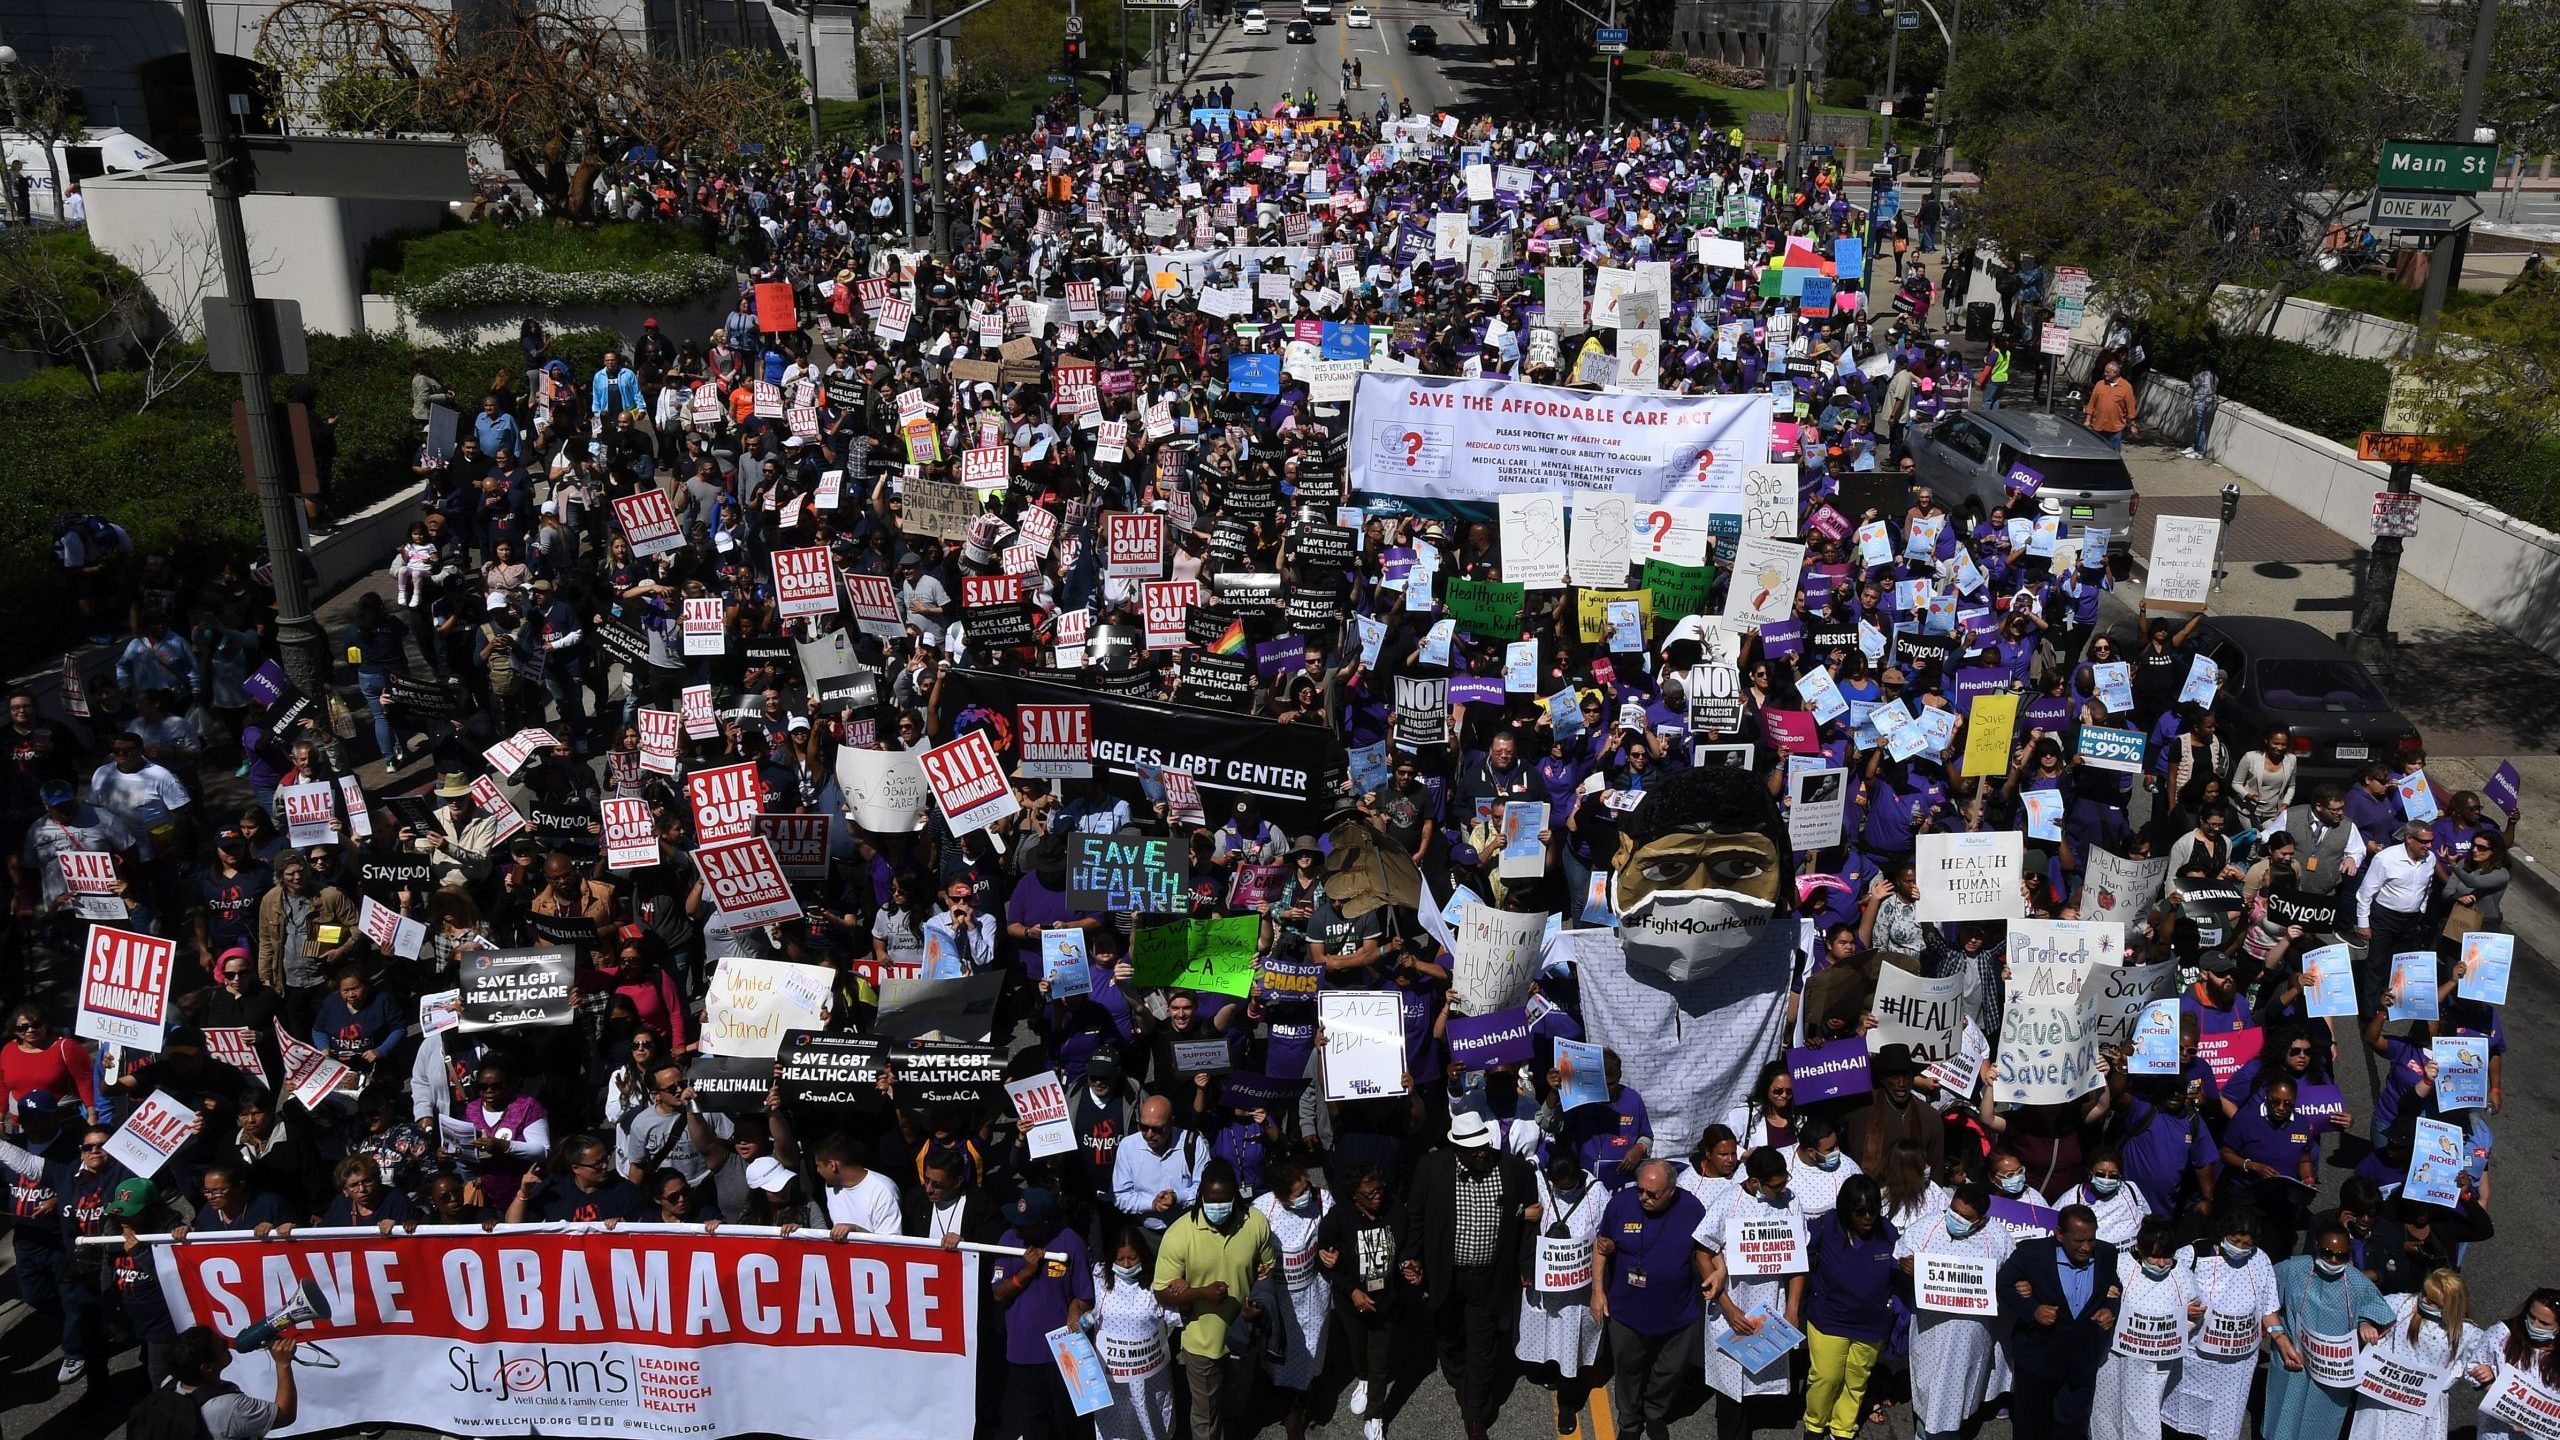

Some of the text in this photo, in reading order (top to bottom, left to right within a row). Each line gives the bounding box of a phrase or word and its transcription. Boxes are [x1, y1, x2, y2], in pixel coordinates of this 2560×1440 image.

[1602, 31, 1622, 39] Main
[2391, 154, 2485, 174] Main St
[2383, 200, 2453, 219] ONE WAY
[1409, 391, 1711, 426] SAVE THE AFFORDABLE CARE ACT
[1496, 428, 1621, 446] PLEASE PROTECT MY HEALTH CARE
[967, 451, 1006, 464] SAVE
[1465, 441, 1652, 463] MEDICAID CUTS WILL HURT OUR ABILITY ACQUIRE
[1472, 457, 1642, 476] MEDICAL CARE MENTAL HEALTH SERVICES
[1498, 466, 1614, 482] SUBSTANCE ABUSE TREATMENT
[1498, 475, 1613, 491] DENTAL CARE VISION CARE
[1745, 472, 1783, 497] Save
[2010, 470, 2038, 489] ¡GOL!
[904, 477, 974, 501] HEALTHCARE
[619, 493, 667, 526] SAVE
[1113, 520, 1159, 539] SAVE
[1115, 539, 1158, 554] OUR
[2187, 535, 2203, 545] DIE
[778, 551, 827, 576] SAVE
[1112, 551, 1160, 563] HEALTHCARE
[782, 573, 828, 589] OUR
[783, 586, 830, 600] HEALTHCARE
[686, 601, 721, 620] SAVE
[686, 620, 722, 632] OBAMACARE
[1814, 632, 1857, 646] #RESISTE
[747, 648, 790, 659] #HEALTH4ALL
[1260, 647, 1304, 664] #Health4All
[1190, 667, 1242, 682] SAVE LGBT
[823, 682, 875, 701] #HEALTH4ALL
[1182, 677, 1248, 692] HEALTHCARE
[1398, 677, 1446, 706] NO!
[1450, 682, 1502, 695] #Health4All
[1692, 668, 1740, 699] NO!
[1960, 677, 2009, 691] #Health4All
[1692, 697, 1740, 709] ILLEGITIMATE
[1397, 707, 1444, 720] ILLEGITIMATE
[1975, 704, 2005, 727] Save
[1022, 709, 1088, 747] SAVE
[2082, 727, 2143, 745] Healthcare
[1023, 744, 1088, 761] OBAMACARE
[2080, 739, 2141, 762] for the 99%
[925, 737, 989, 792] SAVE
[1169, 751, 1307, 792] LGBT CENTER
[884, 769, 917, 786] Save
[694, 769, 756, 806] SAVE
[882, 784, 919, 798] OBAMA
[942, 773, 1003, 816] OBAMACARE
[288, 792, 331, 815] SAVE
[887, 796, 920, 810] CARE!
[289, 811, 335, 825] OBAMACARE
[605, 802, 650, 824] SAVE
[698, 798, 760, 827] OUR
[608, 821, 654, 840] OUR
[610, 835, 657, 849] HEALTHCARE
[703, 843, 768, 880] SAVE
[1082, 840, 1166, 868] SAVE
[1941, 855, 2007, 871] HEALTH
[362, 864, 432, 883] STAY LOUD!
[1071, 866, 1180, 892] HEALTH
[715, 873, 778, 896] OUR
[1948, 877, 2000, 893] HUMAN
[722, 887, 786, 910] HEALTHCARE
[1106, 890, 1189, 914] CARE
[1957, 890, 2001, 906] RIGHT
[2182, 889, 2241, 902] #HEALTH4ALL
[2268, 893, 2300, 921] STAY
[1625, 914, 1767, 939] #Fight4OurHealth
[2009, 931, 2089, 966] Protect
[92, 932, 166, 992] SAVE
[1264, 961, 1323, 976] CARE NOT
[477, 971, 559, 989] SAVE LGBT
[1263, 974, 1318, 993] CHAOS
[89, 983, 160, 1020] OBAMACARE
[467, 985, 568, 1005] HEALTHCARE
[488, 1008, 546, 1023] #SaveACA
[715, 1009, 780, 1040] Stand!
[1452, 1025, 1527, 1052] #Health4All
[792, 1052, 871, 1067] SAVE LGBT
[781, 1067, 877, 1083] HEALTHCARE
[694, 1078, 769, 1094] #HEALTH4ALL
[799, 1089, 856, 1103] #SaveACA
[134, 1099, 193, 1136] SAVE
[126, 1118, 177, 1155] OBAMACARE
[1741, 1228, 1793, 1241] 1.6 Million
[1739, 1240, 1796, 1253] NEW CANCER
[1542, 1251, 1576, 1262] 43 Kids
[1746, 1253, 1782, 1263] PATIENTS
[1758, 1264, 1782, 1273] 2017?
[1928, 1269, 1983, 1285] 5.4 Million
[199, 1248, 943, 1342] SAVE OBAMACARE
[1925, 1293, 1989, 1309] ALZHEIMER'S?
[2118, 1331, 2155, 1347] PROSTATE
[2202, 1335, 2232, 1348] BIRTH
[1106, 1339, 1161, 1359] 27.6 Million
[639, 1358, 701, 1373] LEADING
[640, 1372, 700, 1386] CHANGE
[641, 1386, 713, 1400] THROUGH
[2383, 1388, 2427, 1408] CANCER?
[2507, 1381, 2527, 1401] 24
[514, 1396, 629, 1409] Well Child Family Center
[644, 1399, 697, 1414] HEALTH
[453, 1415, 573, 1427] WWW.WELLCHILD.ORG
[622, 1417, 717, 1434] @WELLCHILDORG
